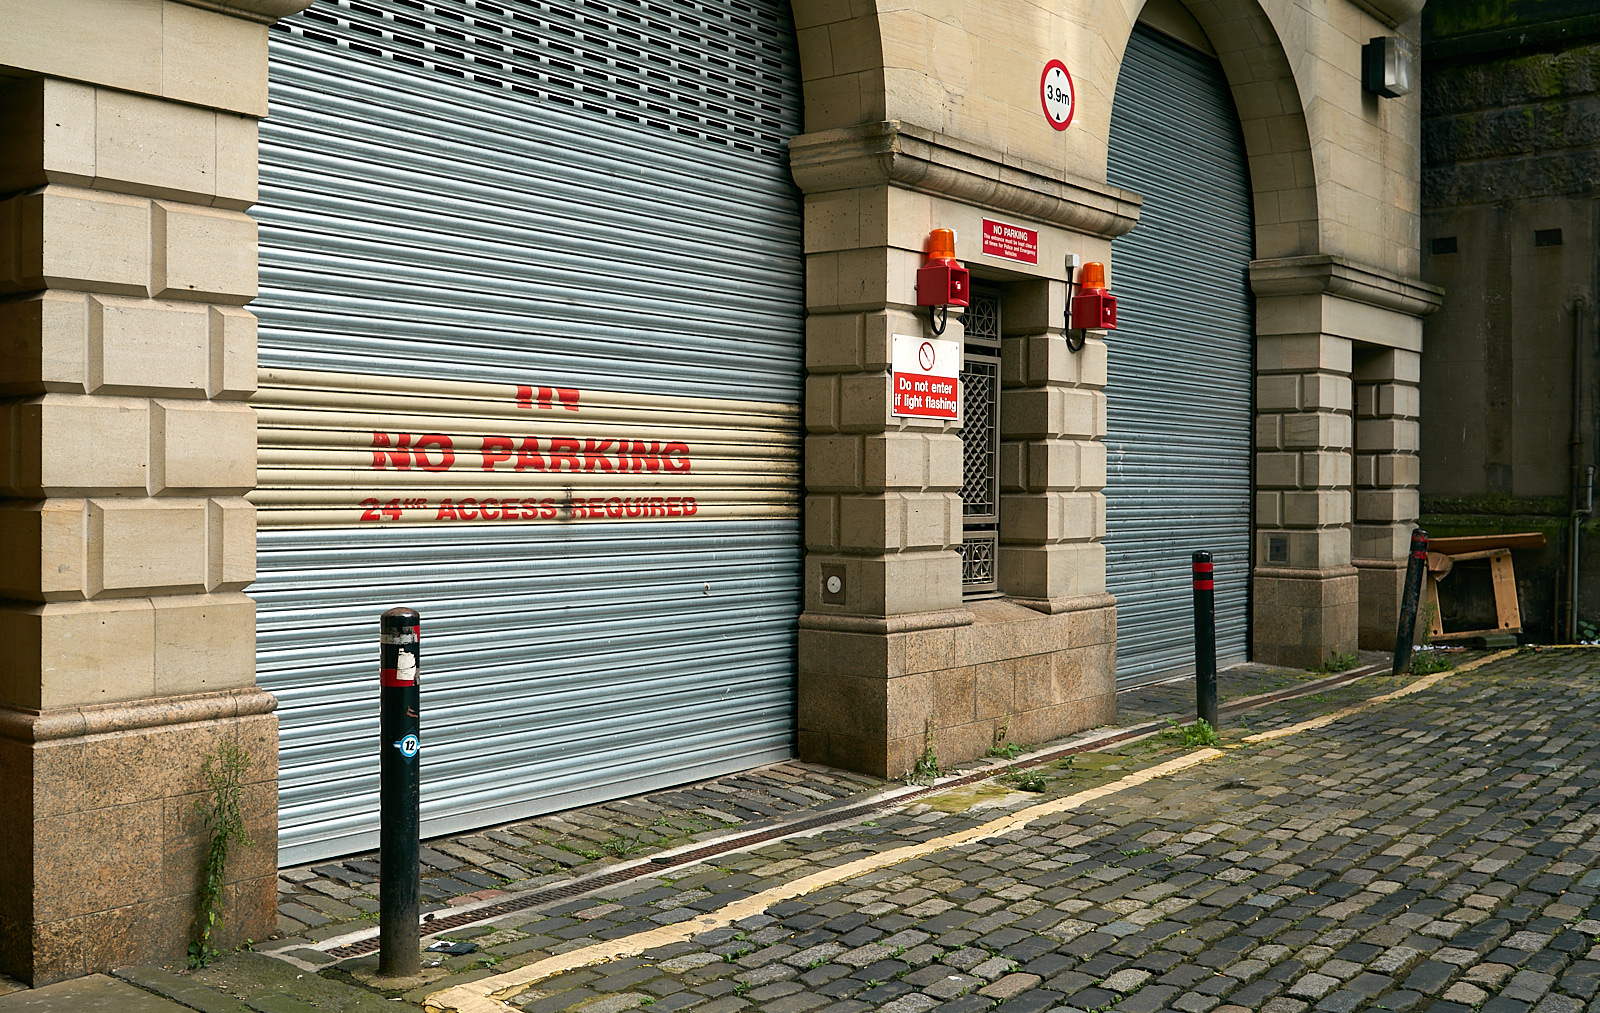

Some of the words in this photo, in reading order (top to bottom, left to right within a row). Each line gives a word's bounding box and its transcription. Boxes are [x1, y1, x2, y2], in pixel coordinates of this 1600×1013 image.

[1047, 85, 1069, 105] 3.9m
[993, 225, 1002, 235] NO
[1004, 228, 1028, 241] PARKING
[899, 377, 911, 390] Do
[915, 380, 928, 392] not
[931, 382, 952, 394] enter
[895, 393, 901, 406] if
[904, 393, 922, 410] light
[925, 395, 956, 413] flashing
[371, 432, 455, 473] NO
[481, 434, 691, 474] PARKING
[435, 497, 557, 521] ACCESS
[570, 496, 698, 519] REQUIRED
[405, 740, 415, 751] 12
